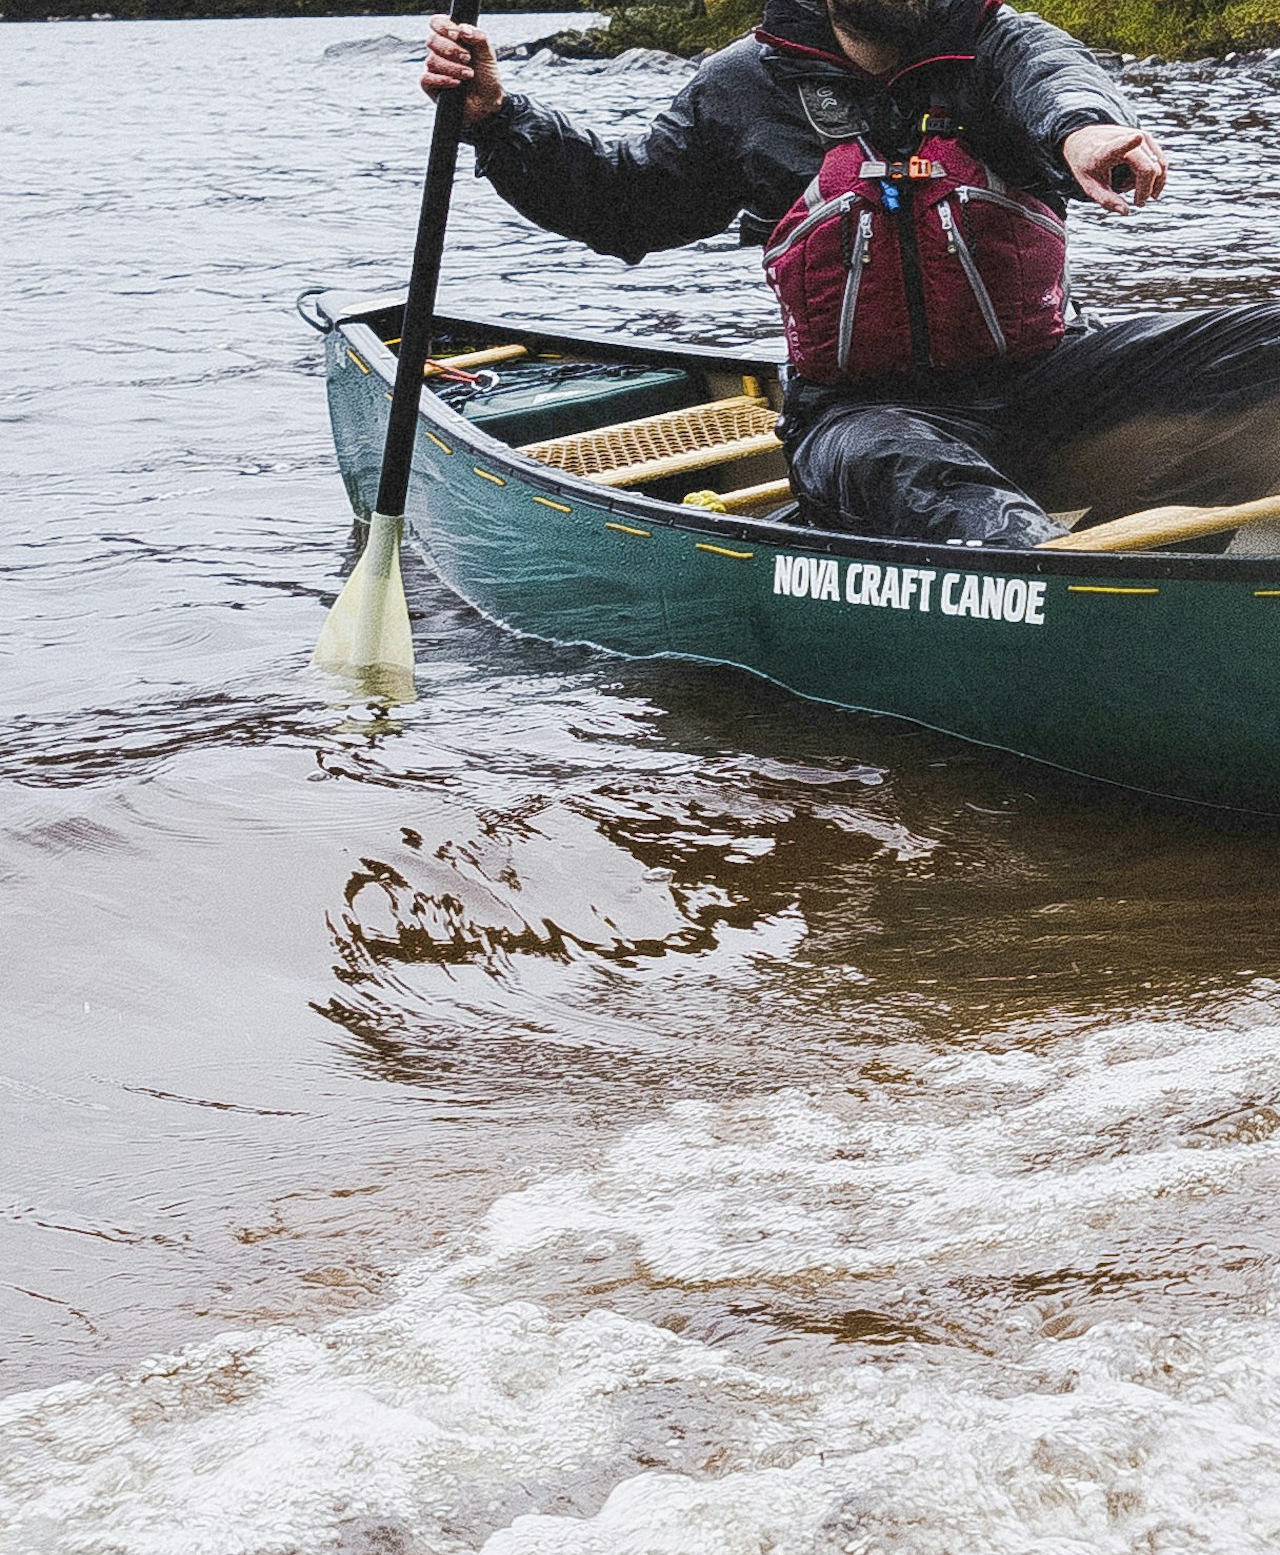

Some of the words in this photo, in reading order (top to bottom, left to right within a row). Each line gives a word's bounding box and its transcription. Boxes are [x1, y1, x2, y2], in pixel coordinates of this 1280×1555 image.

[773, 554, 840, 602] NOVA
[846, 563, 936, 612] CRAFT
[941, 572, 1047, 625] CANOE
